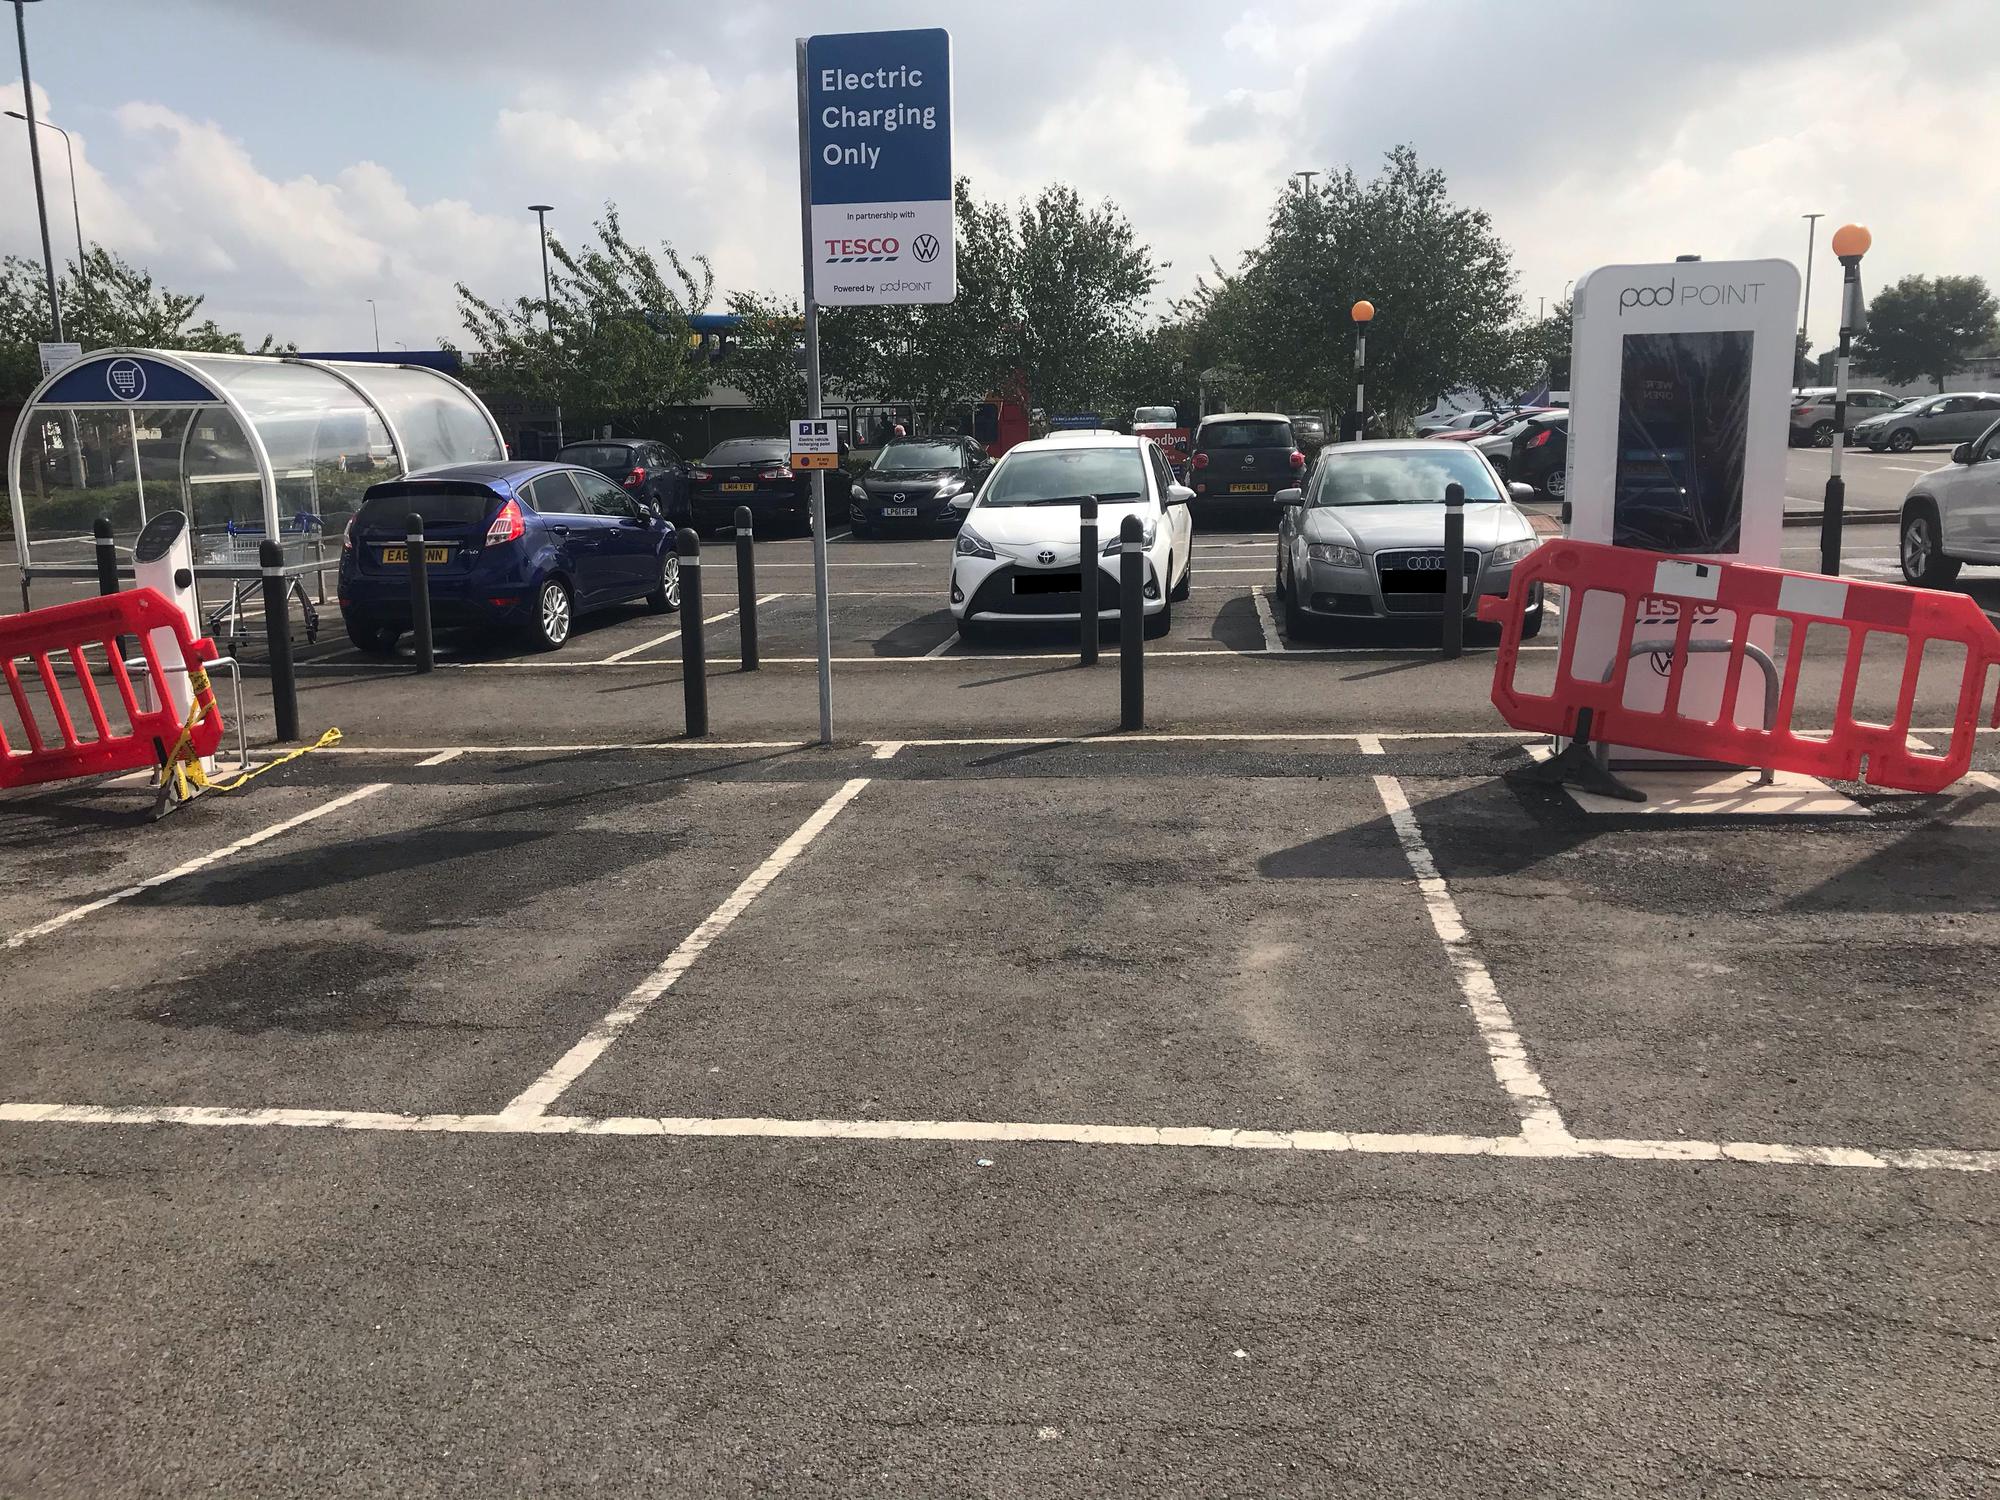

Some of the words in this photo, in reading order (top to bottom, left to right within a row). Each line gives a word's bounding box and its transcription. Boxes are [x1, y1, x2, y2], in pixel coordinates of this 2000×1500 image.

[822, 65, 923, 91] Electric
[822, 102, 937, 131] Charging
[823, 142, 880, 169] Only
[847, 212, 854, 221] In
[855, 211, 898, 222] partnership
[899, 210, 915, 219] with
[824, 237, 900, 255] TESCO
[833, 285, 864, 293] Powered
[866, 284, 875, 293] by
